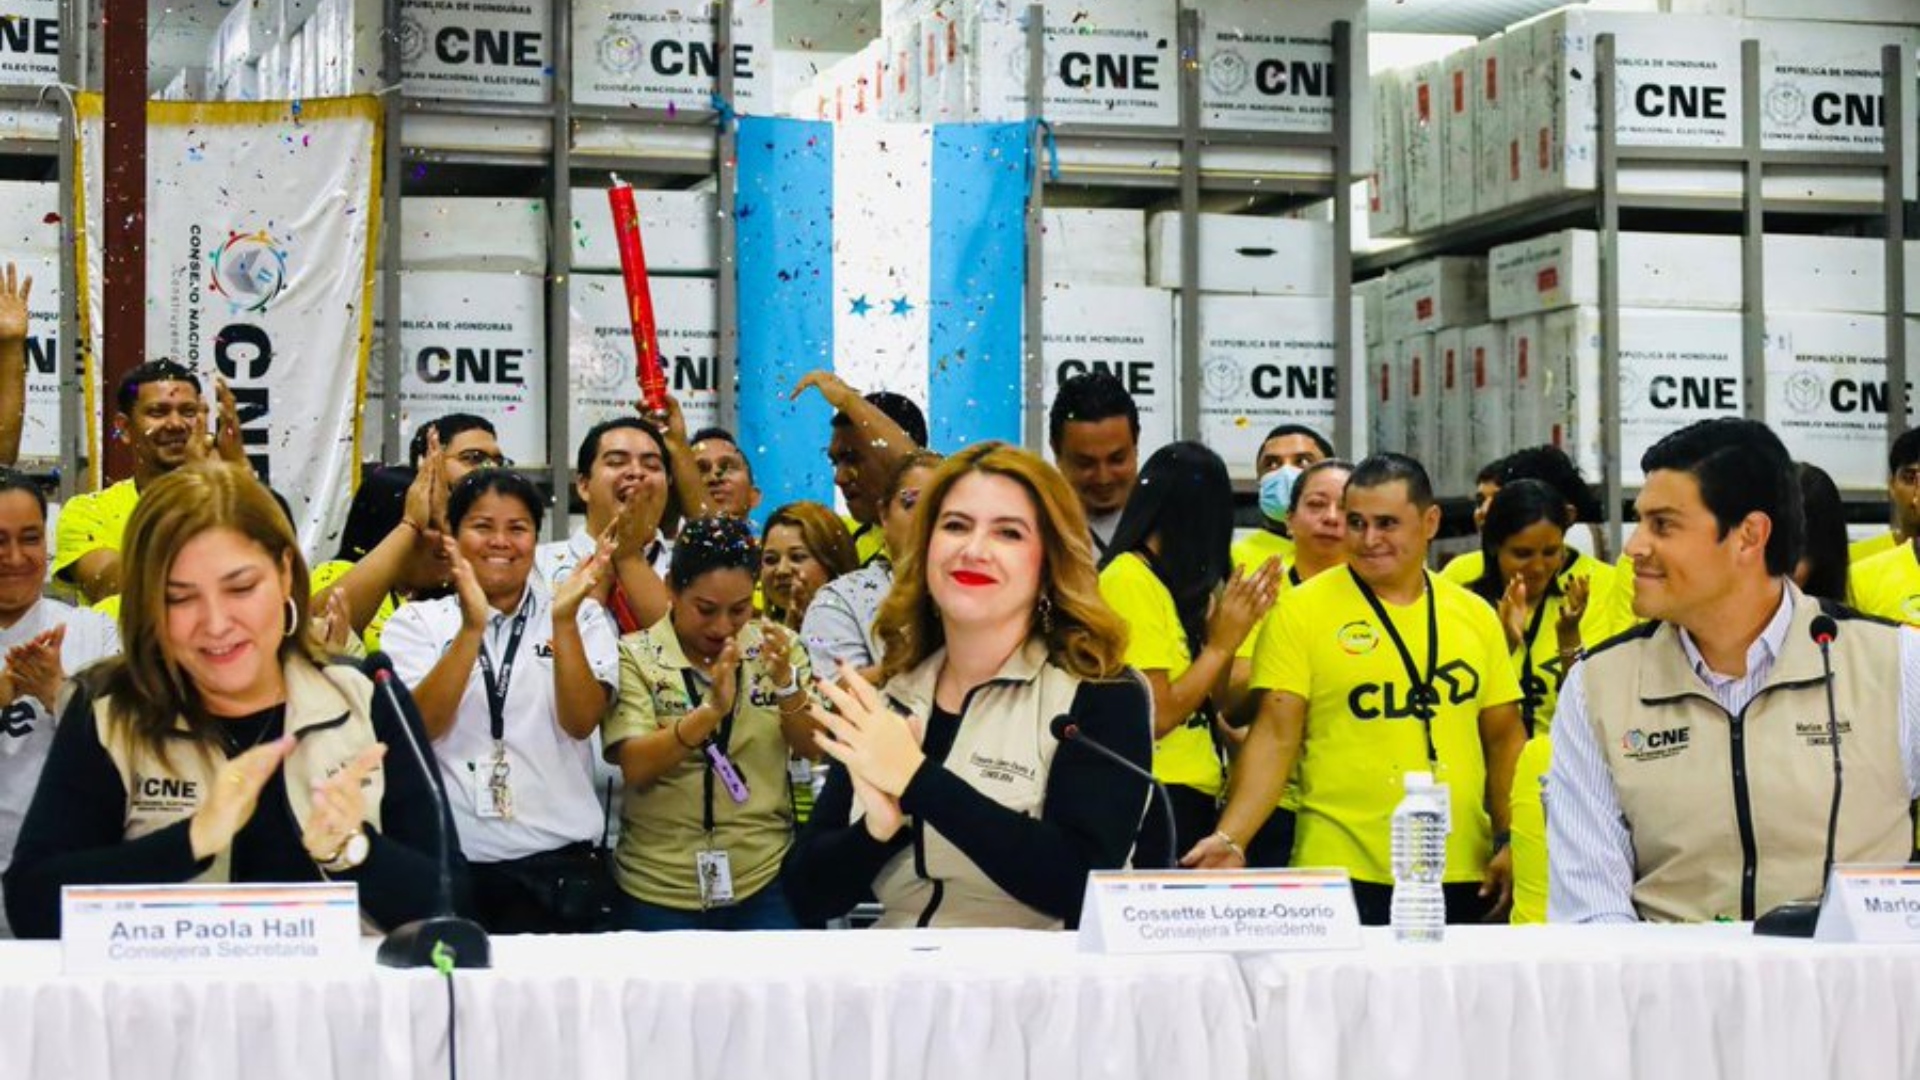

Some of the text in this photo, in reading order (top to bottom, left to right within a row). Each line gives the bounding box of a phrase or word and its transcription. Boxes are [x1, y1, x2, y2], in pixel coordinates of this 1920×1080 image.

[0, 17, 58, 53] NE
[435, 26, 542, 67] CNE
[650, 39, 753, 78] CNE
[1060, 51, 1159, 90] CNE
[1635, 84, 1726, 118] CNE
[188, 309, 200, 374] NACION
[416, 346, 523, 384] CNE
[1649, 374, 1737, 409] CNE
[1648, 727, 1690, 748] CNE
[144, 778, 197, 797] CNE
[1123, 902, 1334, 924] Cossette López-Osorio
[1864, 897, 1920, 913] Marlo
[110, 917, 315, 941] Ana Paola Hall
[1139, 921, 1326, 944] Consejera Presidente
[108, 940, 318, 964] Consejera Secretaria
